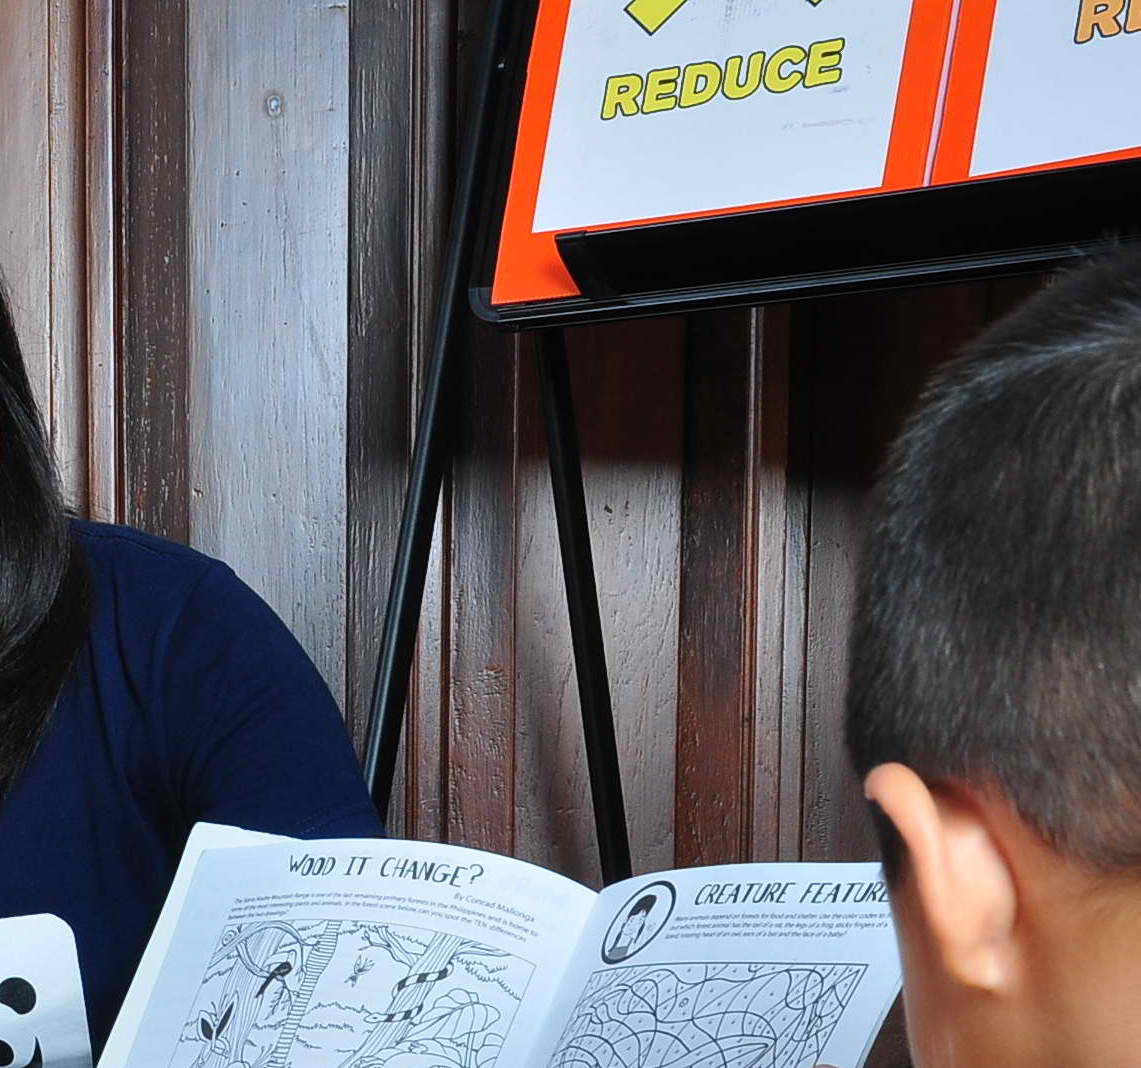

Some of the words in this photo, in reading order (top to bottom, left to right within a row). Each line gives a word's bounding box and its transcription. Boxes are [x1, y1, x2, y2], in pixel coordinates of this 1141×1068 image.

[601, 38, 845, 120] REDUCE
[289, 854, 337, 877] WOOD
[343, 855, 368, 877] IT
[380, 856, 485, 887] CHANGE?
[453, 892, 463, 901] By
[465, 896, 495, 909] Conrad
[693, 882, 796, 906] CREATURE
